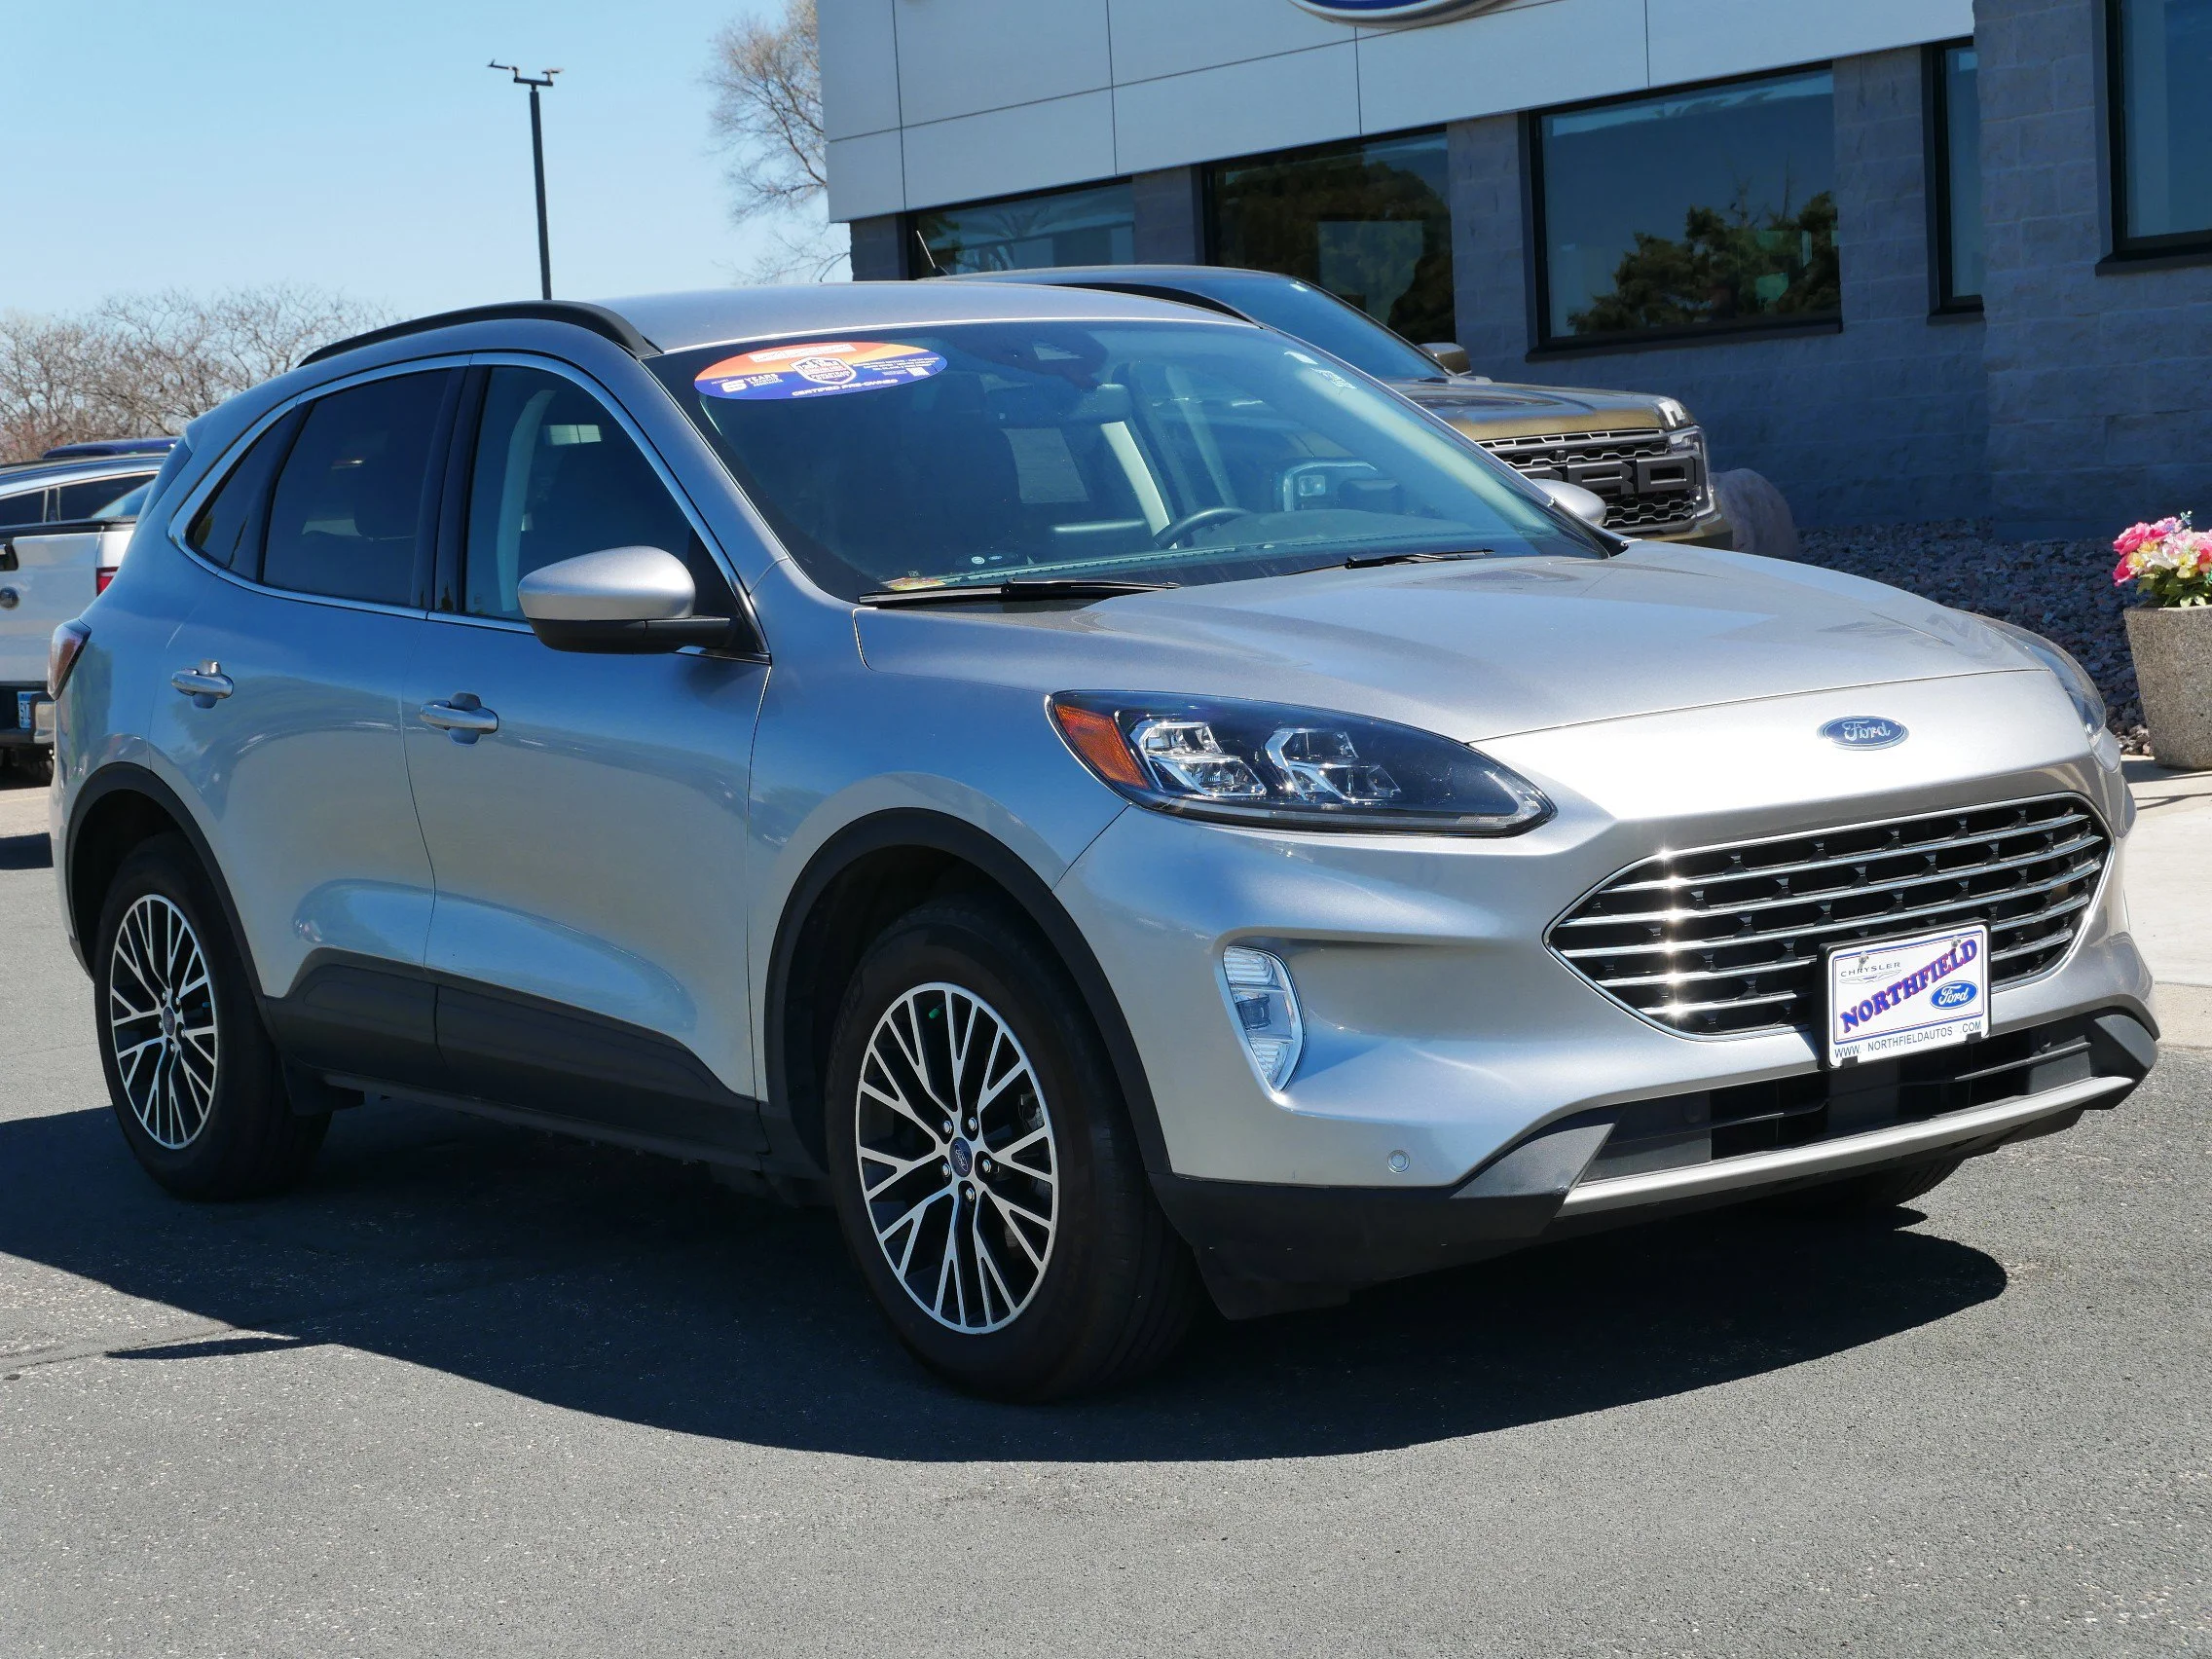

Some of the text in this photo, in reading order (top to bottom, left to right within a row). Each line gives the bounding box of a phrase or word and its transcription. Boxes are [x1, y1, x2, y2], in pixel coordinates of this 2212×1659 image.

[792, 379, 899, 396] CERTIFIED PRE-OWNED
[1841, 720, 1891, 741] Ford
[1840, 962, 1900, 977] CHRYSLER
[1839, 939, 1978, 1034] NORTHFIELD
[1937, 985, 1969, 1005] Ford
[1867, 1026, 1953, 1051] NORTHFIELDAUTOS
